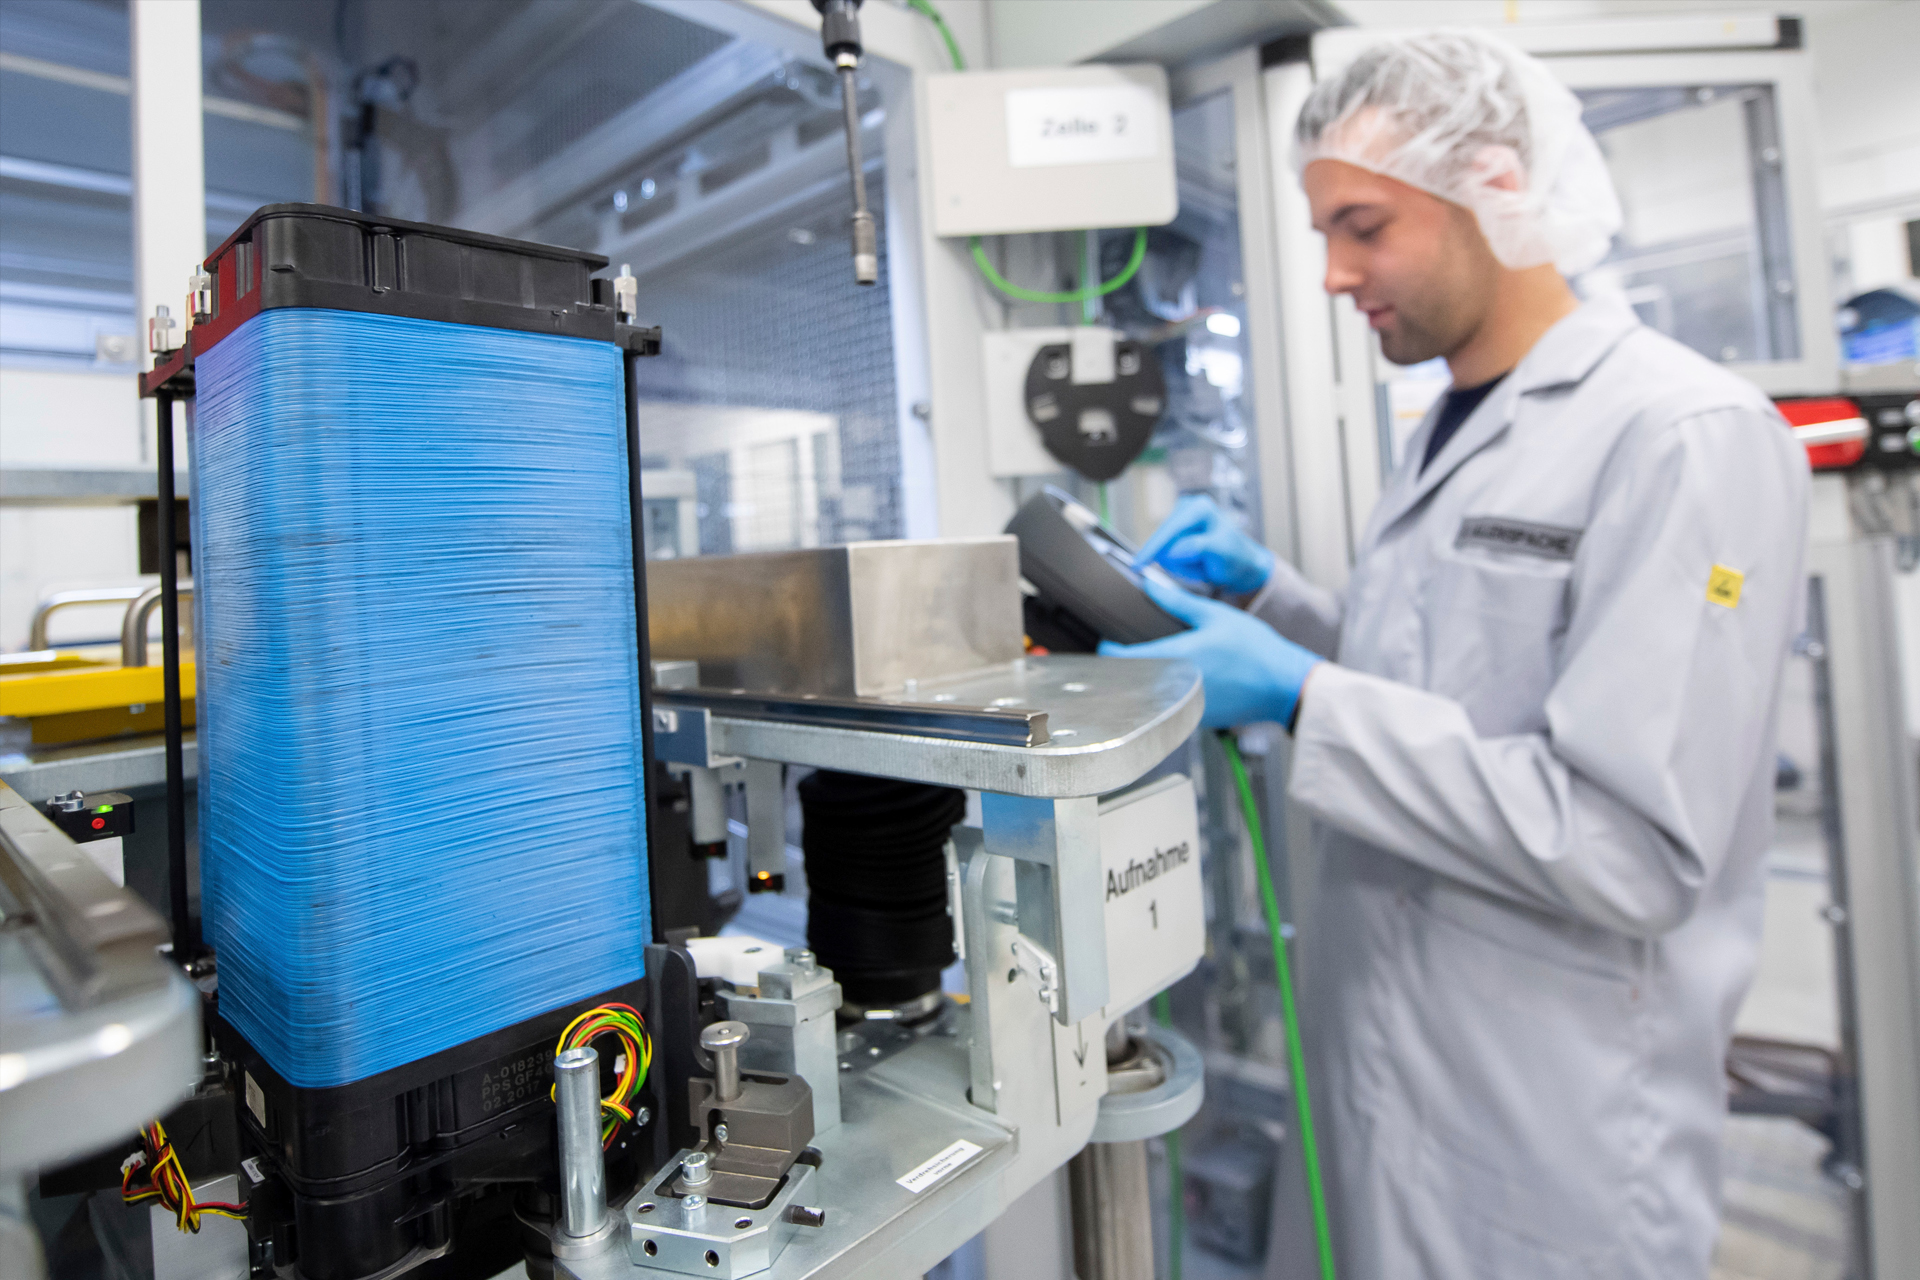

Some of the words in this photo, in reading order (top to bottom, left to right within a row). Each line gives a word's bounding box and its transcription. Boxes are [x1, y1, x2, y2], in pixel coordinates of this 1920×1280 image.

[1040, 115, 1100, 137] Zelle
[1112, 112, 1130, 137] 2
[1105, 841, 1190, 903] Aufnahme
[1149, 899, 1158, 930] 1
[482, 1049, 553, 1086] A-018239
[482, 1079, 512, 1100] PPS
[483, 1080, 540, 1112] 02.2017
[906, 1147, 965, 1184] Verdrehsicherung
[933, 1162, 952, 1176] vorne
